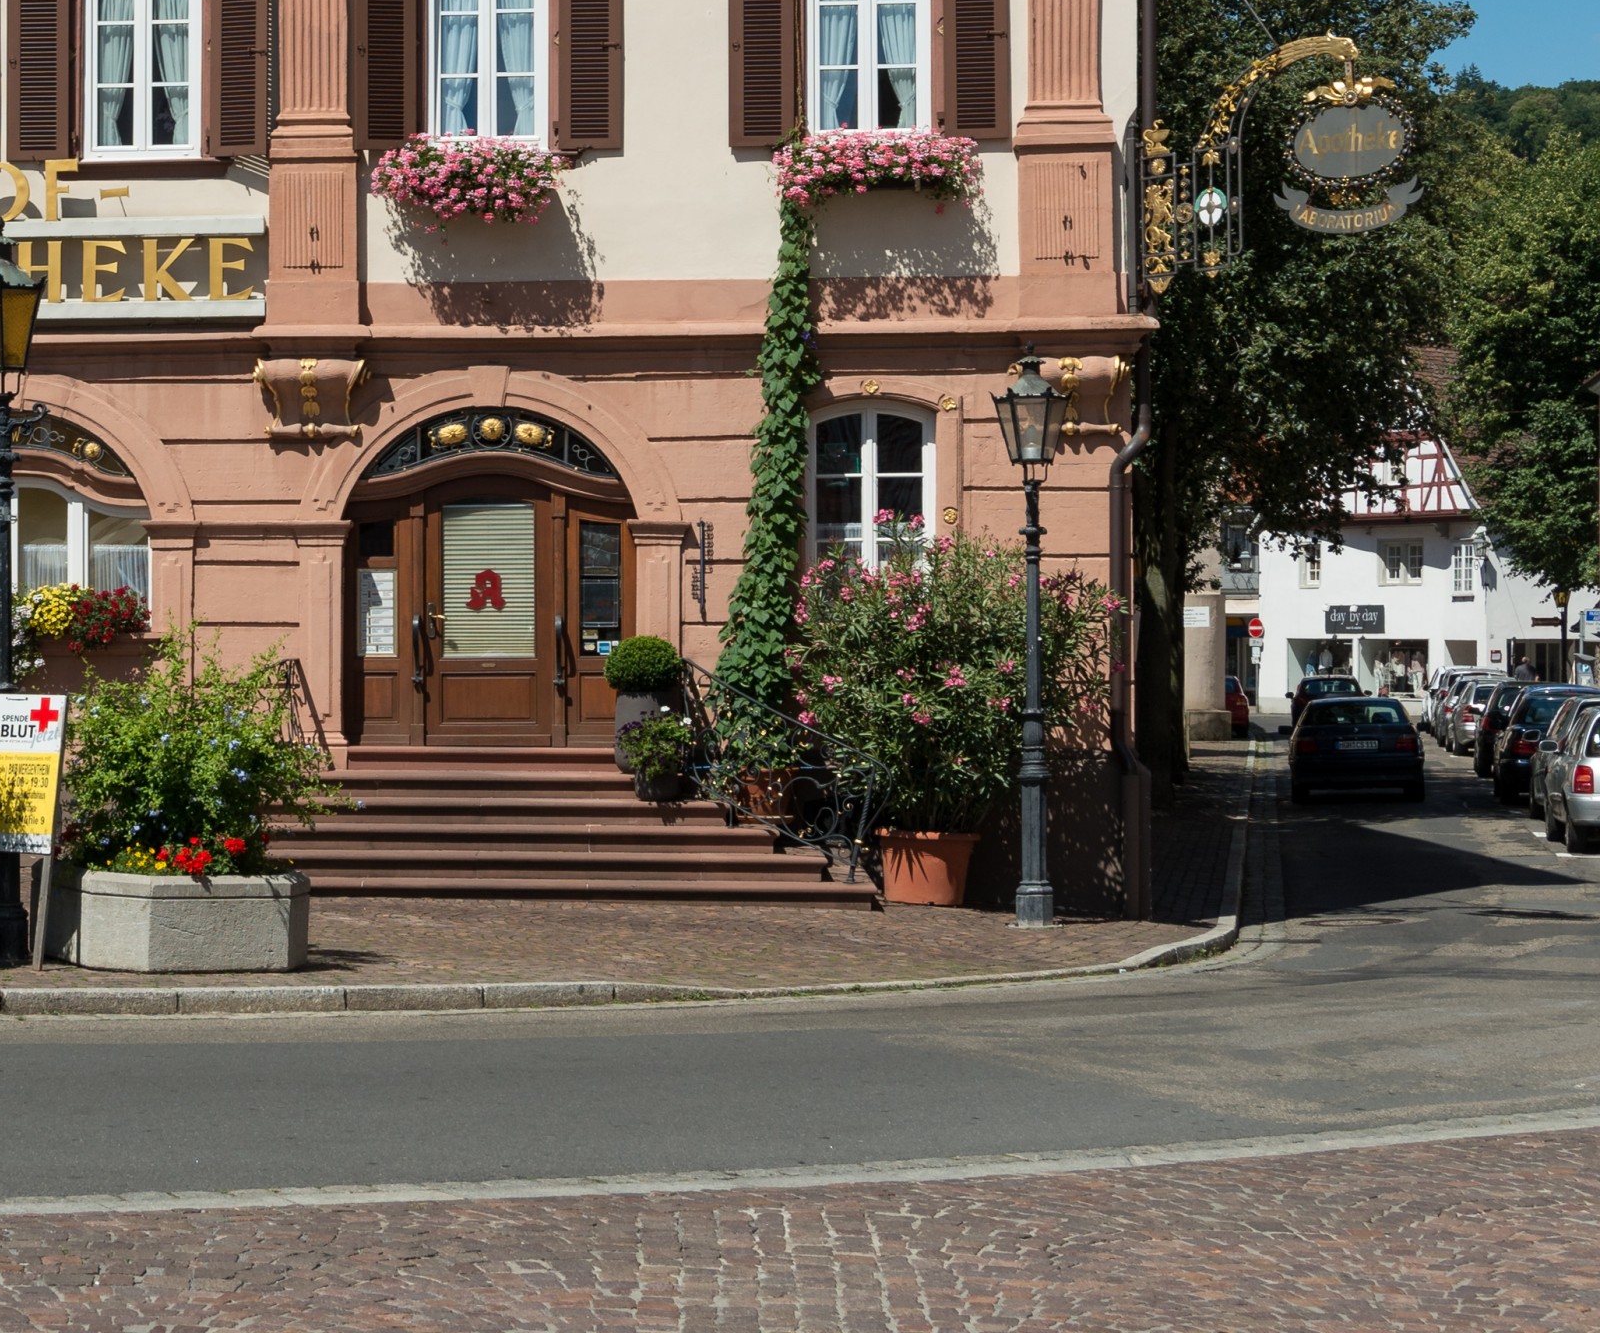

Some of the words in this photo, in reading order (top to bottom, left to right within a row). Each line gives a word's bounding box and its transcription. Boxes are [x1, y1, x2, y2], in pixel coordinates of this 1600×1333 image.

[1300, 121, 1402, 161] Apotheke
[1295, 201, 1401, 229] LABORATORIUM
[1330, 609, 1346, 625] day
[1349, 612, 1360, 626] by
[1362, 609, 1378, 625] day
[1, 714, 29, 723] SPENDE
[0, 724, 36, 739] BLUT
[30, 727, 60, 748] jetzt
[31, 777, 49, 788] 19:30
